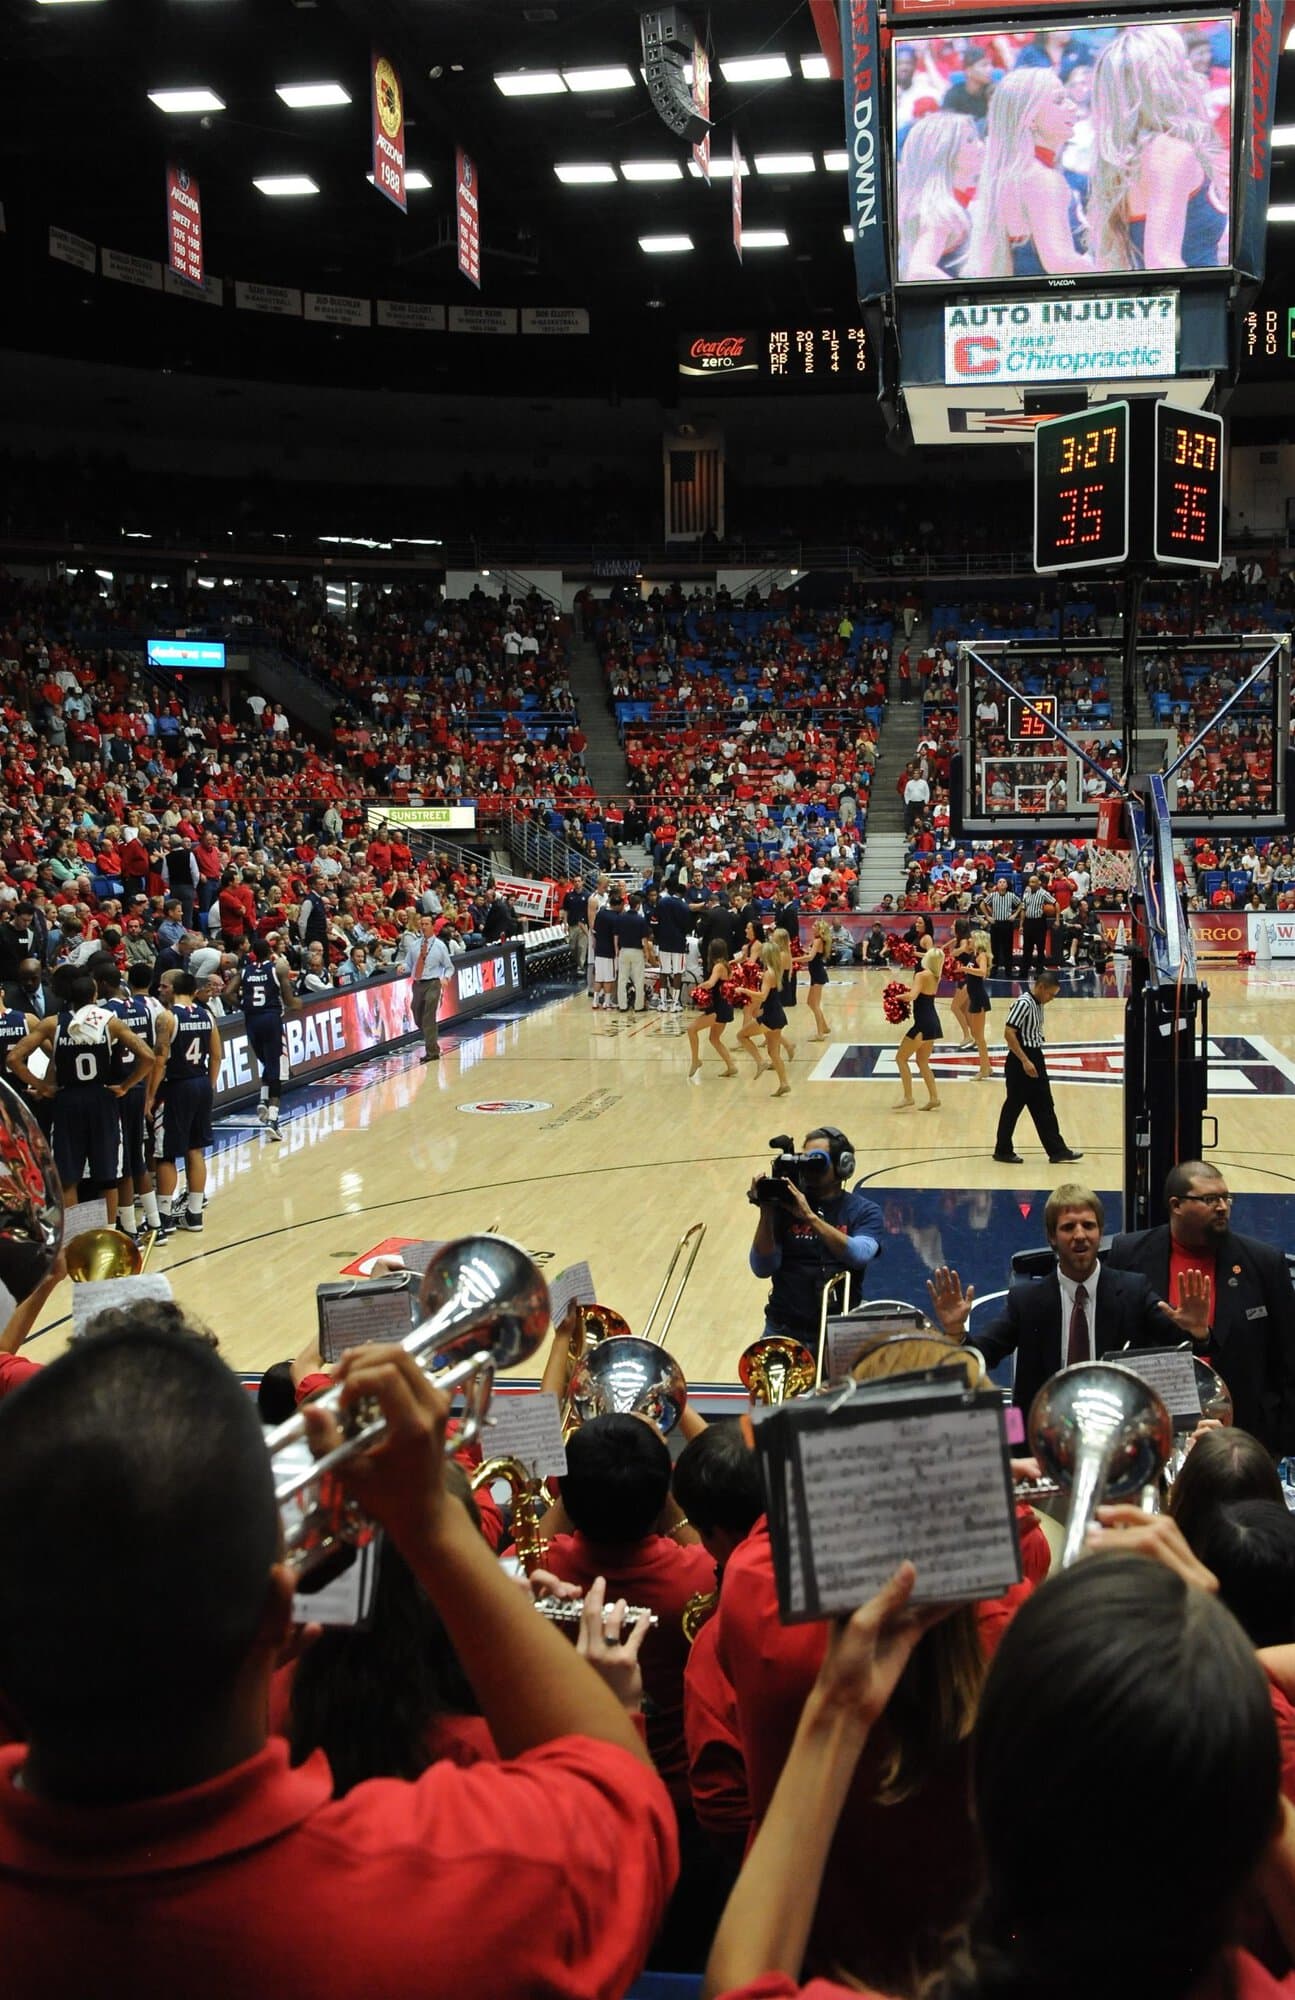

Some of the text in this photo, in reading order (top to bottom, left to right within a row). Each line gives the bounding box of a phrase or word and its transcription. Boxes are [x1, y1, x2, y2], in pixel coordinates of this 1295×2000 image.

[854, 96, 877, 229] DOWN
[381, 161, 400, 194] 1988
[171, 186, 199, 214] ARIZONA
[172, 210, 191, 229] SWEET
[950, 299, 1173, 326] AUTO INJURY?
[769, 342, 789, 353] PTS
[831, 341, 839, 350] 5
[857, 339, 865, 350] 7
[770, 329, 865, 343] NO 20 21 24
[771, 350, 865, 364] RB 2 4 4
[805, 363, 814, 373] 2
[831, 362, 839, 372] 4
[857, 361, 865, 371] 0
[1006, 346, 1162, 372] Chiropractic
[1060, 427, 1117, 474] 3:27
[1175, 429, 1216, 471] 3:27
[1056, 484, 1103, 546] 35
[1171, 482, 1207, 542] 35
[1020, 717, 1044, 734] 35
[391, 810, 447, 820] SUNSTREET
[1193, 927, 1242, 941] ARGO
[253, 986, 266, 1006] 5
[185, 1037, 202, 1065] 4
[216, 1035, 252, 1093] HE
[282, 1007, 346, 1067] BATE
[75, 1053, 97, 1081] 0
